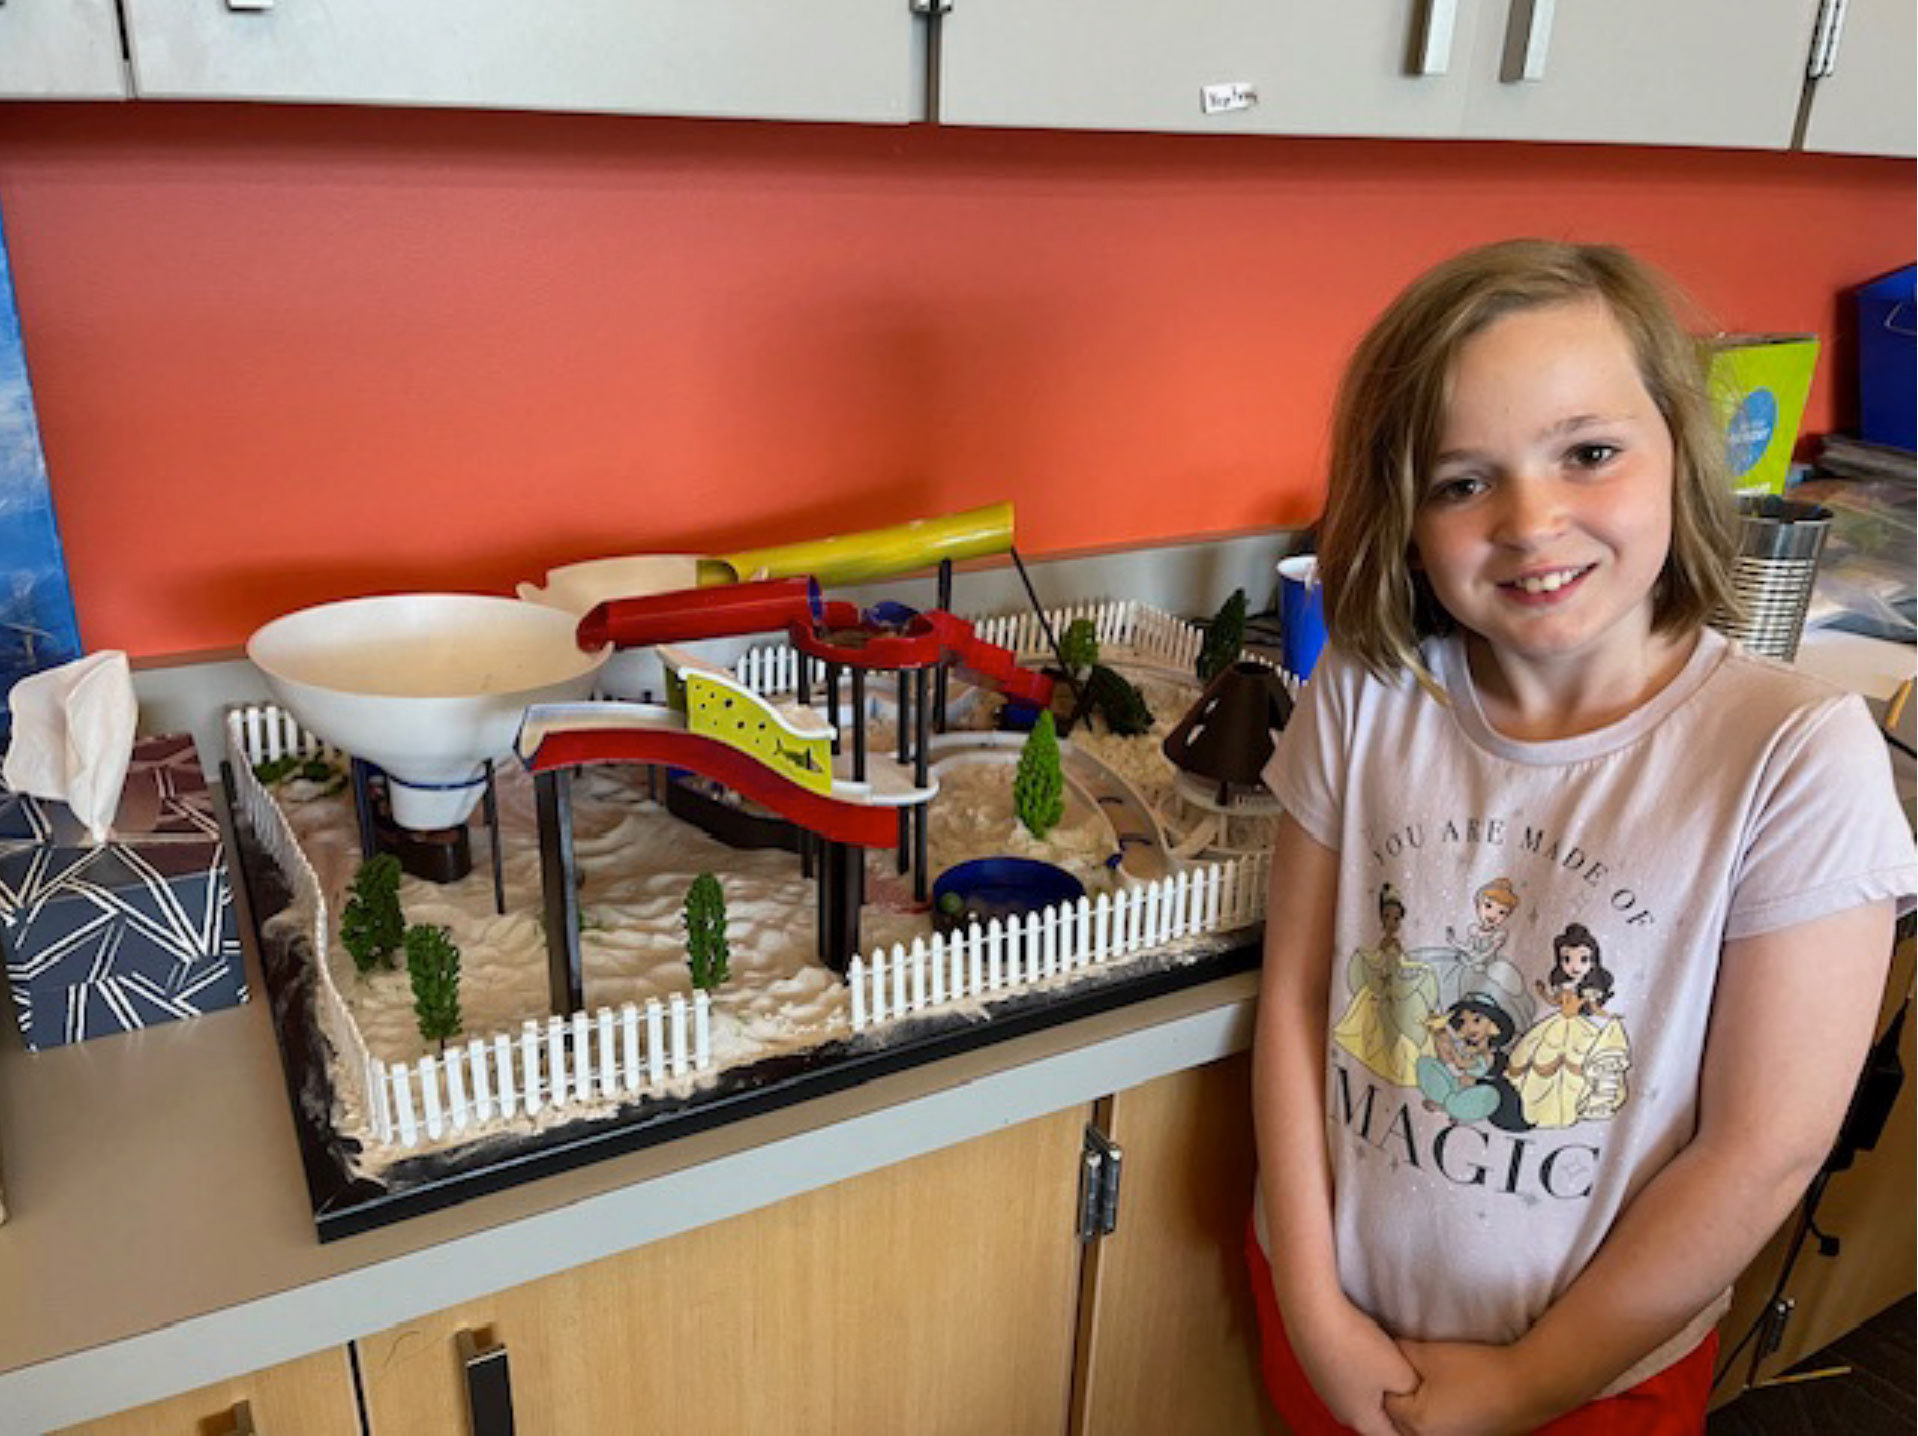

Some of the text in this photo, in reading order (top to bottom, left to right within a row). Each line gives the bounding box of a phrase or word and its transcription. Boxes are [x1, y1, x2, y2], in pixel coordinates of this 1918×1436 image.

[1372, 819, 1655, 929] YOU ARE MADE OF
[1333, 1064, 1600, 1200] MAGIC
